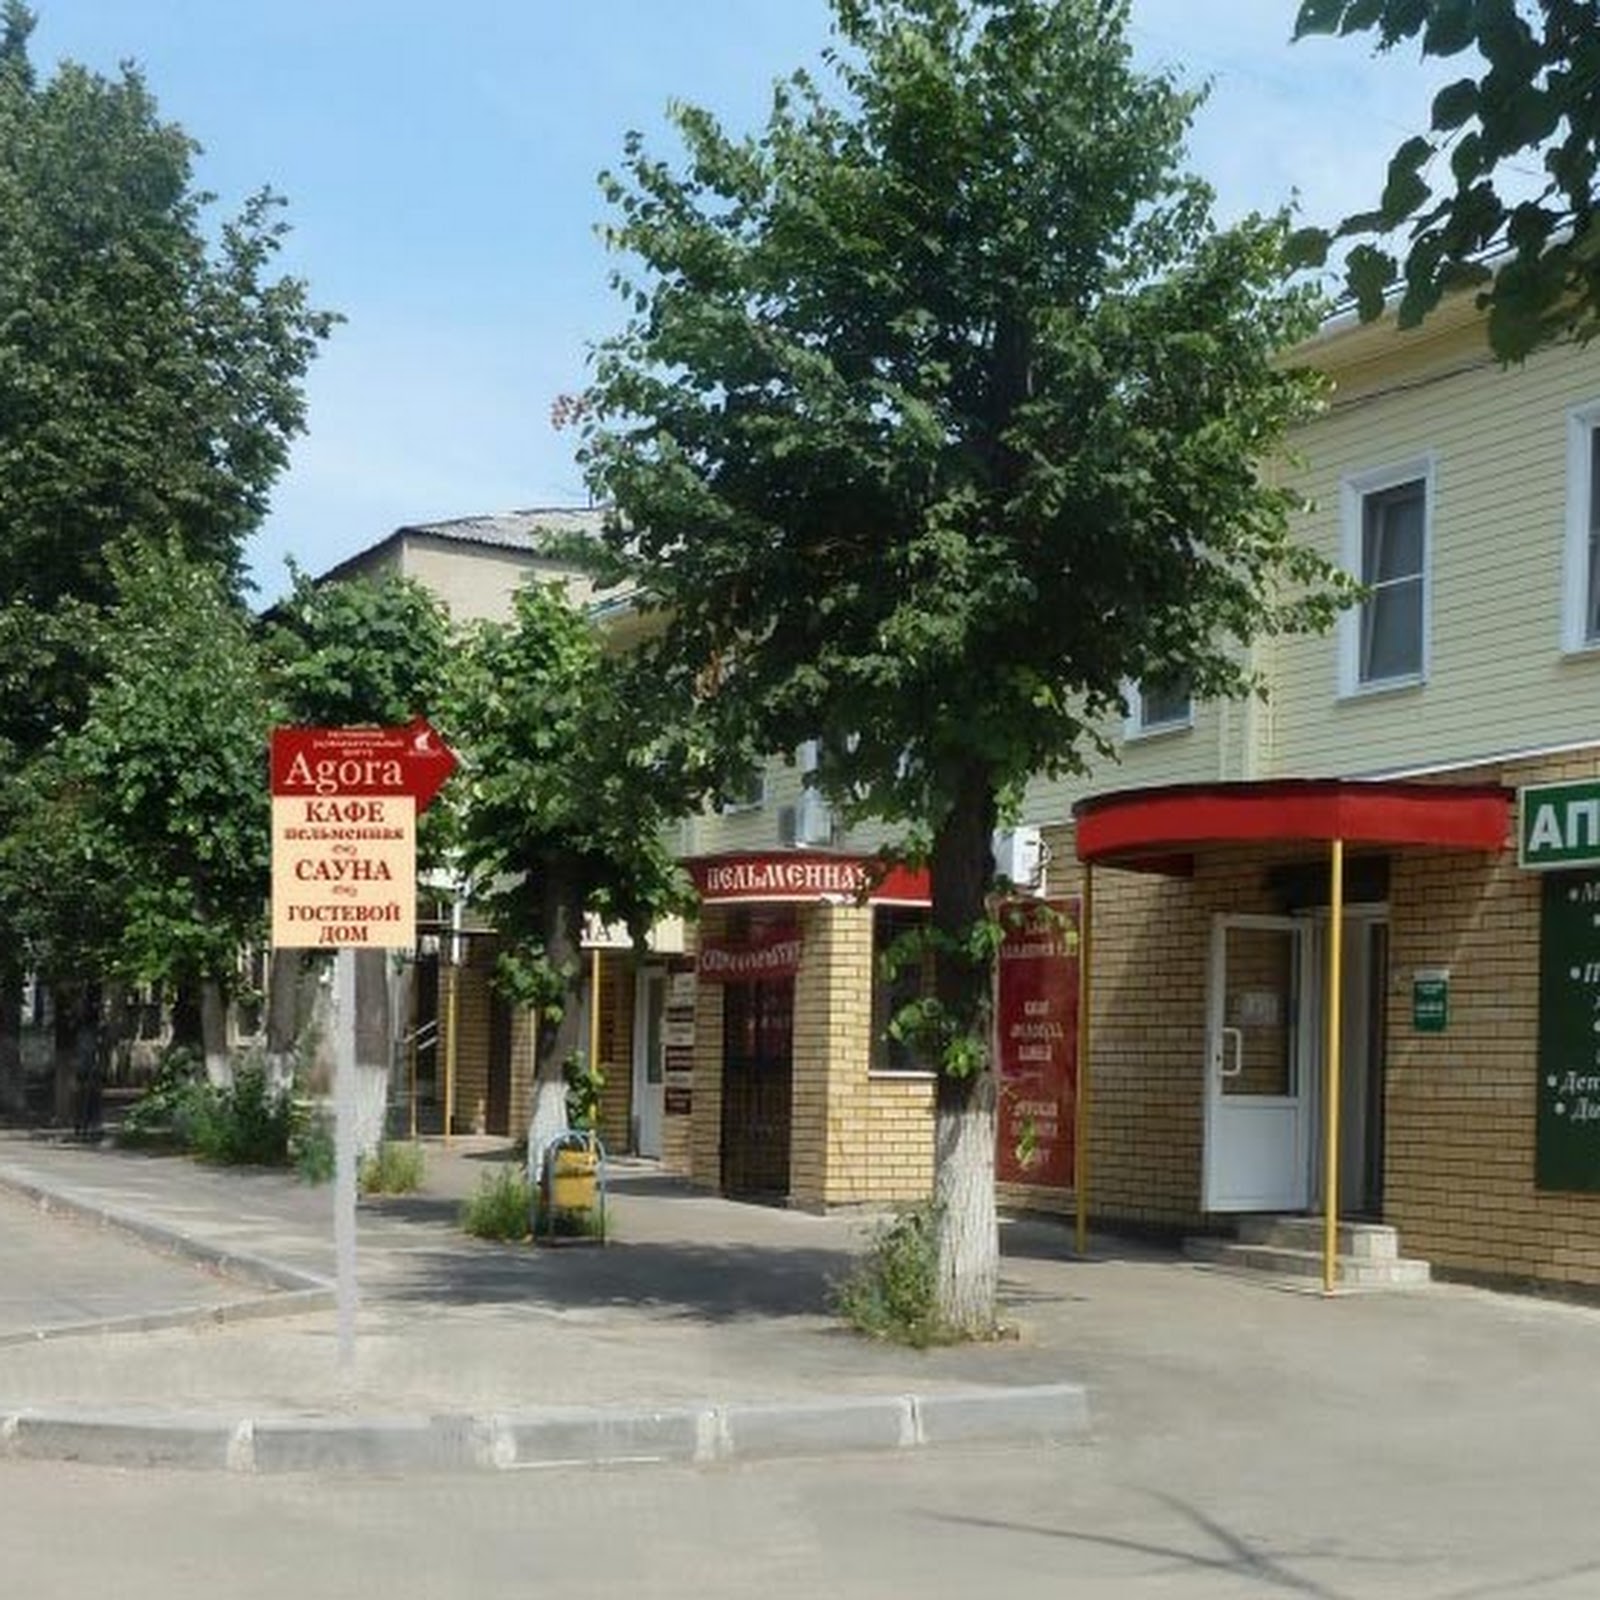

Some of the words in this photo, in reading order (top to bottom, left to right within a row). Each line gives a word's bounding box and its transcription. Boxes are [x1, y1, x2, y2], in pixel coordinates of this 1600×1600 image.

[284, 752, 404, 794] Agora
[305, 801, 384, 823] КАФЕ
[285, 827, 404, 841] пельменная
[295, 858, 392, 881] САУНА
[288, 902, 401, 922] ГОСТЕВОЙ
[318, 926, 369, 944] ДОМ
